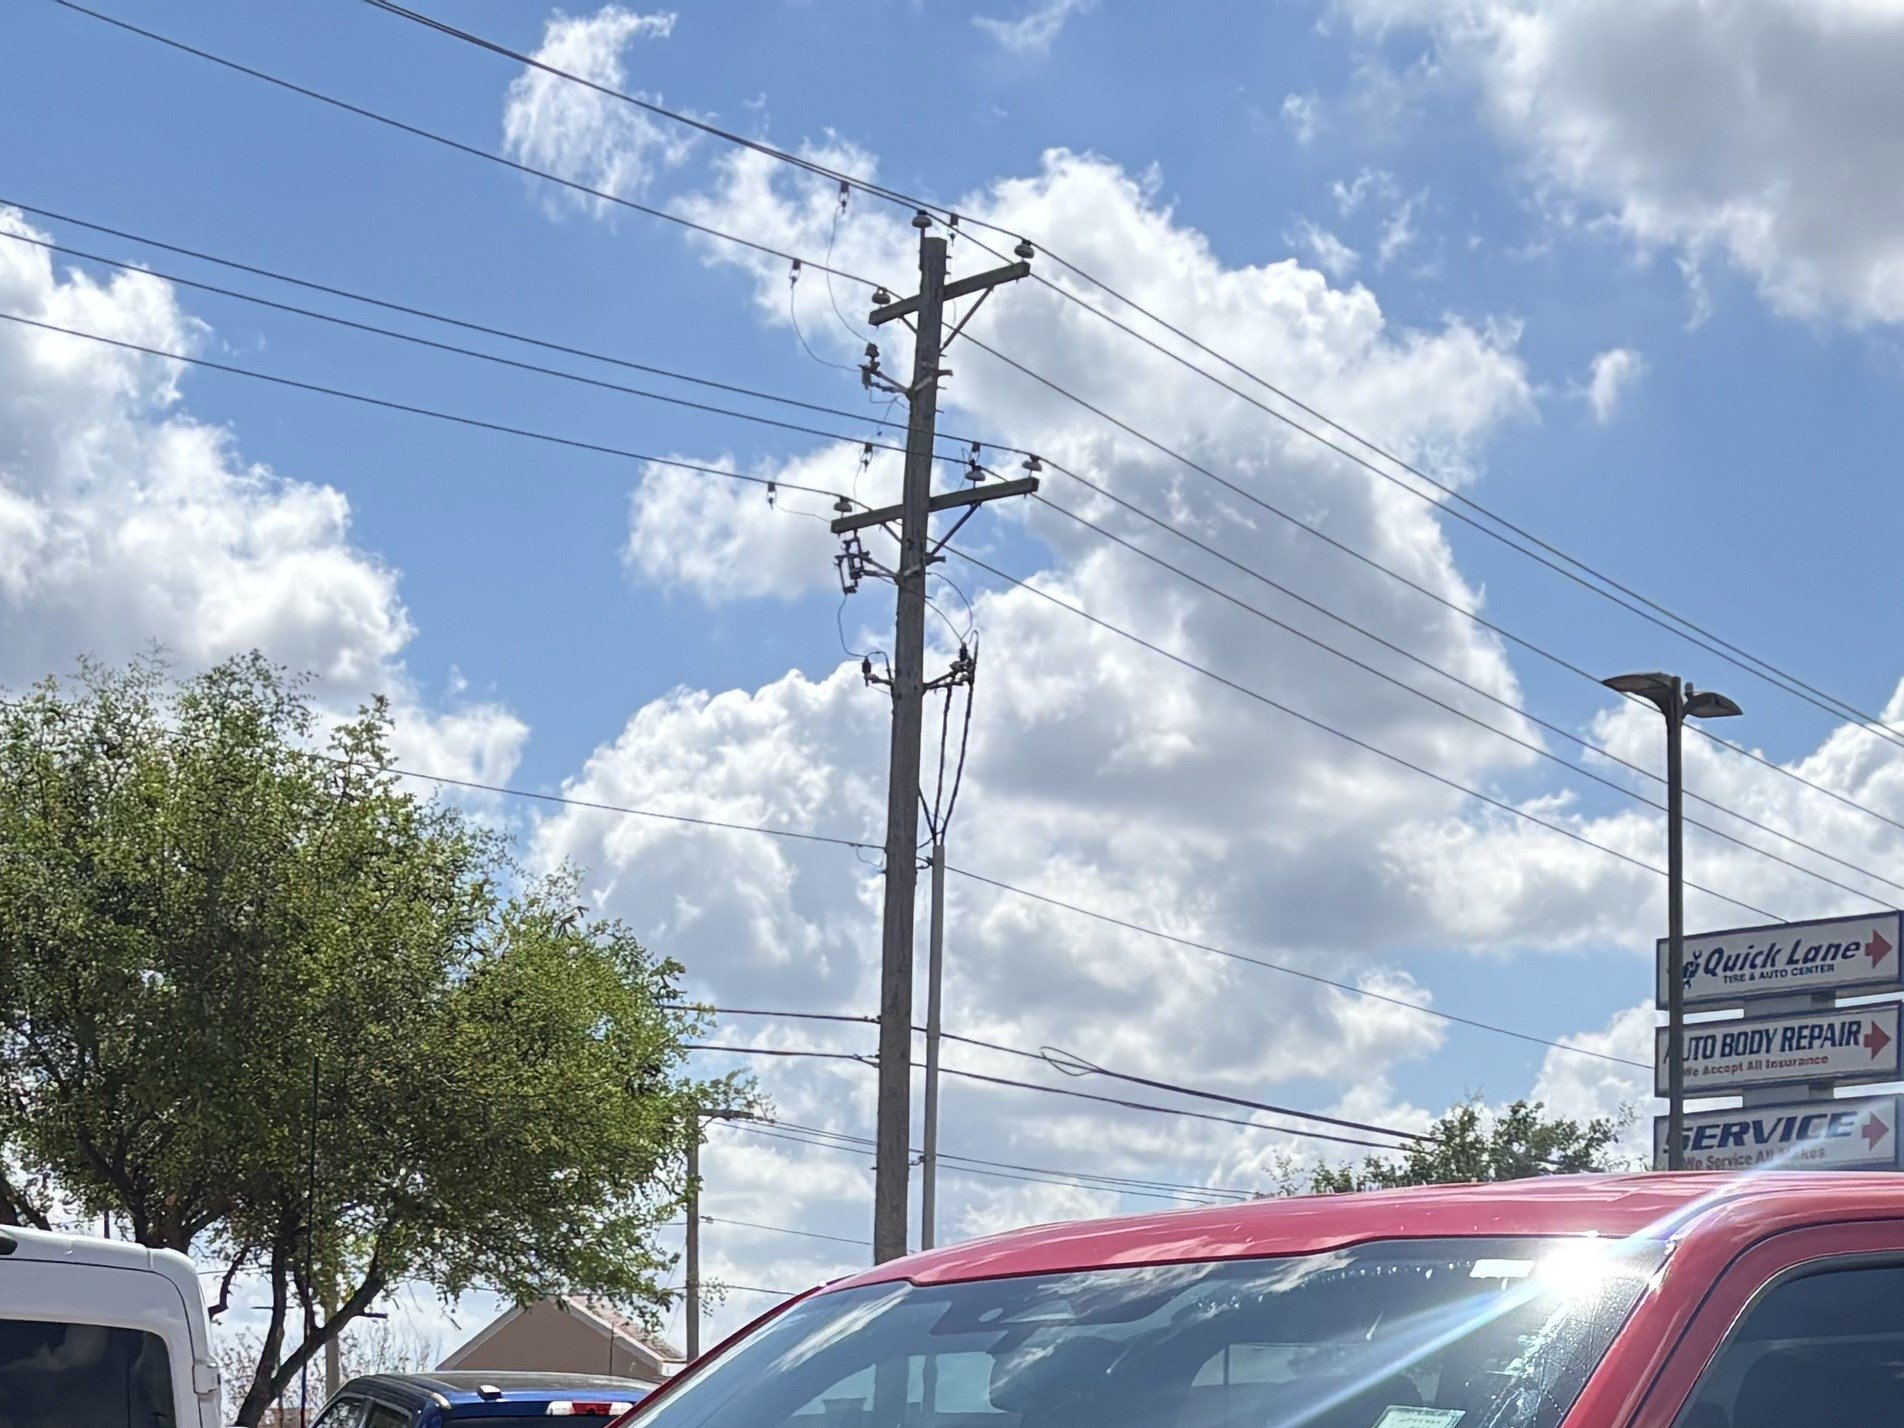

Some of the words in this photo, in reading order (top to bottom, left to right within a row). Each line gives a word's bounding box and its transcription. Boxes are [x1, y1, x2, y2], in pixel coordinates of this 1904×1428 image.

[1704, 941, 1778, 977] Quick
[1786, 939, 1861, 965] Lane
[1759, 968, 1789, 980] AUTO
[1791, 963, 1835, 976] CENTER
[1663, 1034, 1716, 1064] UTO
[1720, 1027, 1778, 1058] BODY
[1780, 1020, 1862, 1052] REPAIR
[1702, 1061, 1744, 1076] Accept
[1746, 1059, 1763, 1071] All
[1765, 1055, 1829, 1070] Insurance
